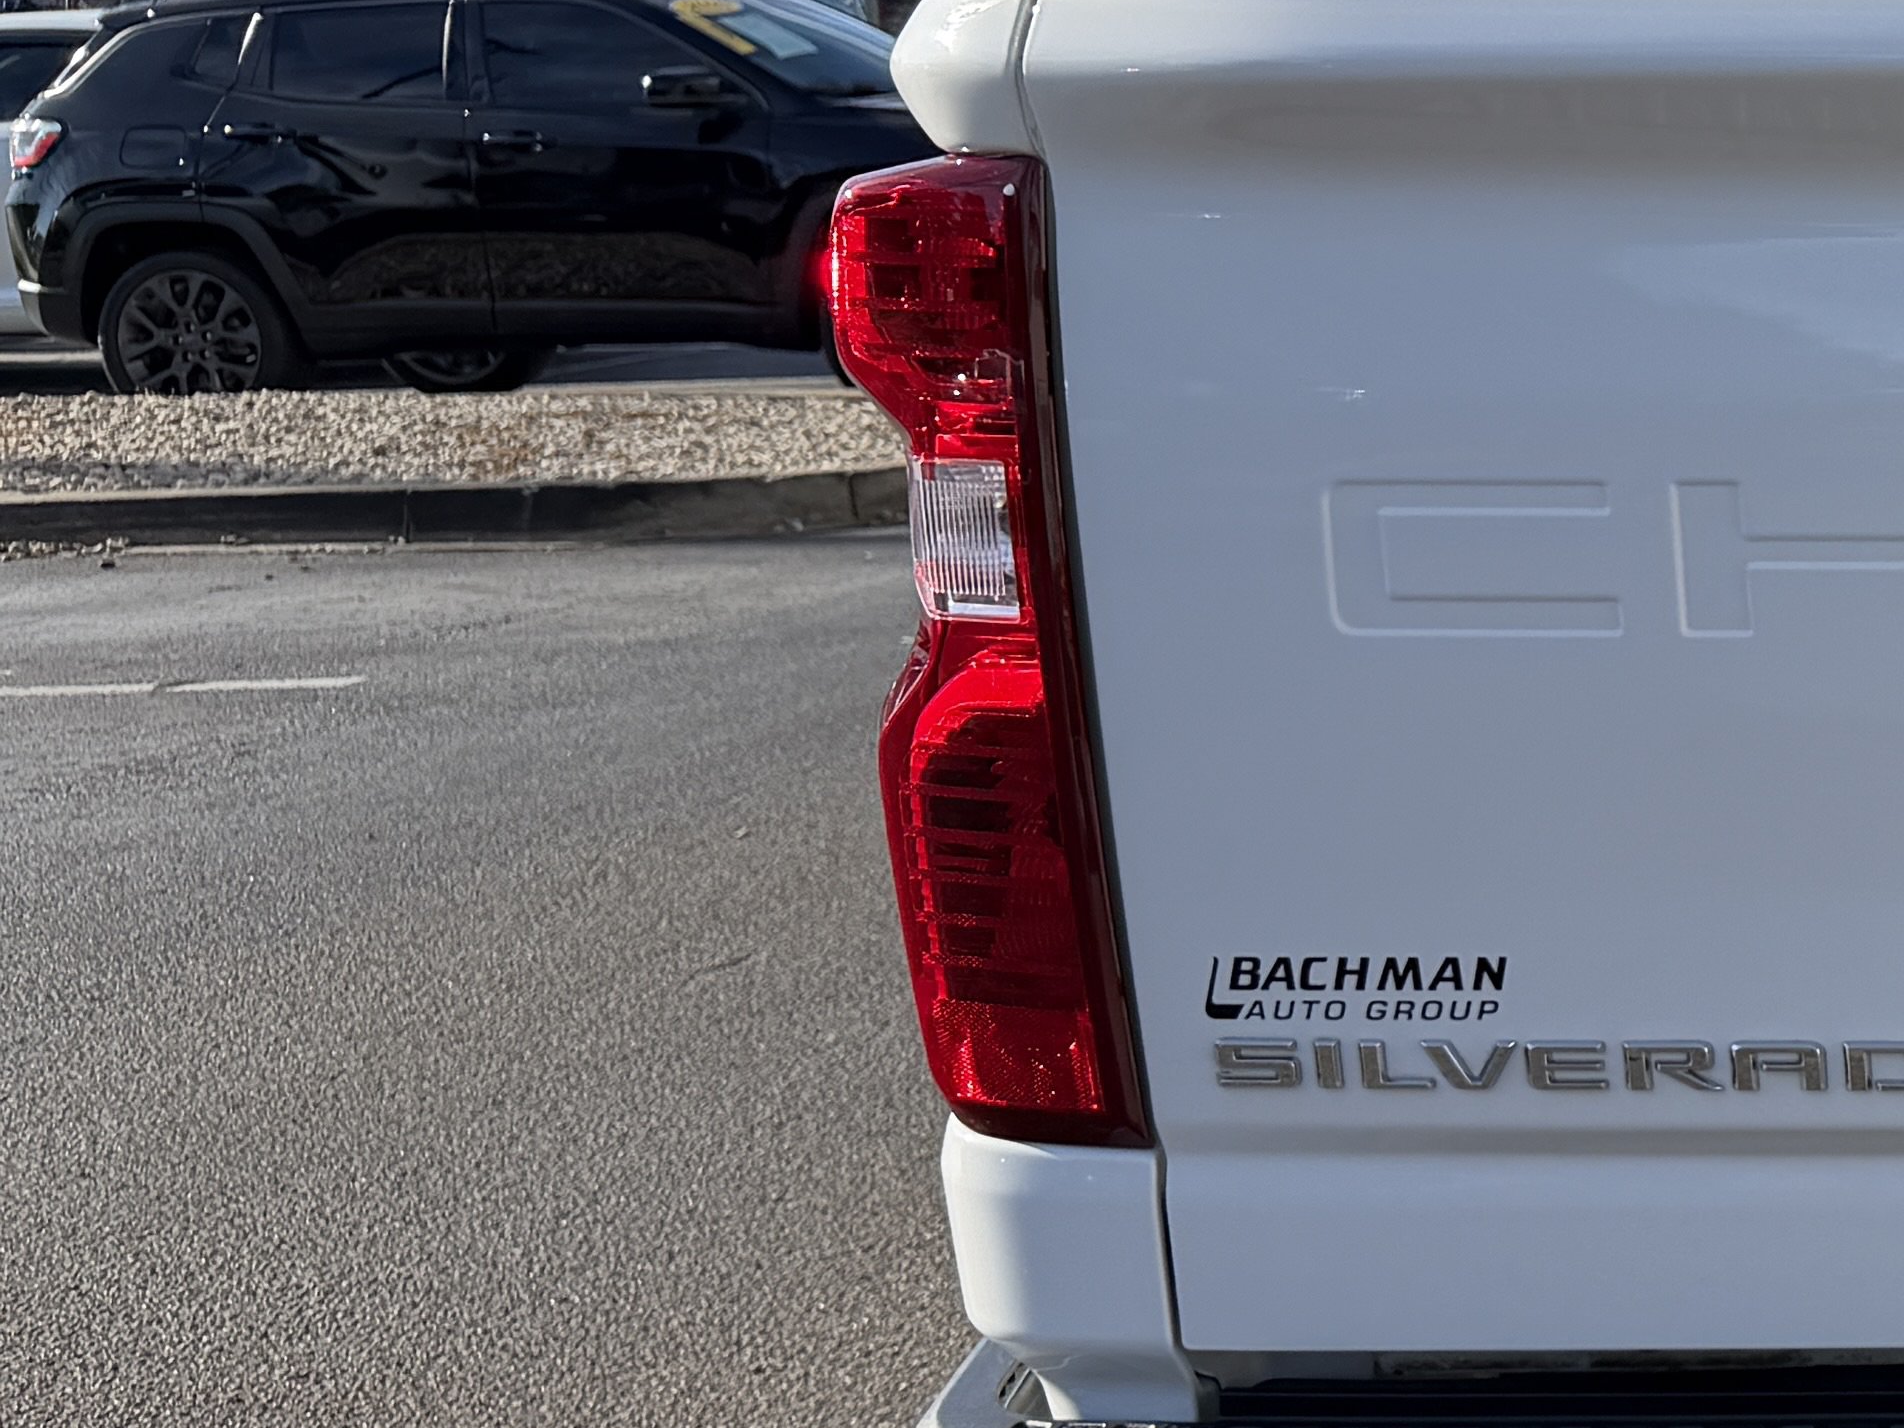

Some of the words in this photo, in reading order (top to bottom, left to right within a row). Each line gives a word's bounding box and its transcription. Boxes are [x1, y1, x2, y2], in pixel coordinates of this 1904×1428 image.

[1229, 956, 1507, 991] BACHMAN
[1244, 1000, 1346, 1020] AUTO
[1366, 1000, 1499, 1020] GROUP
